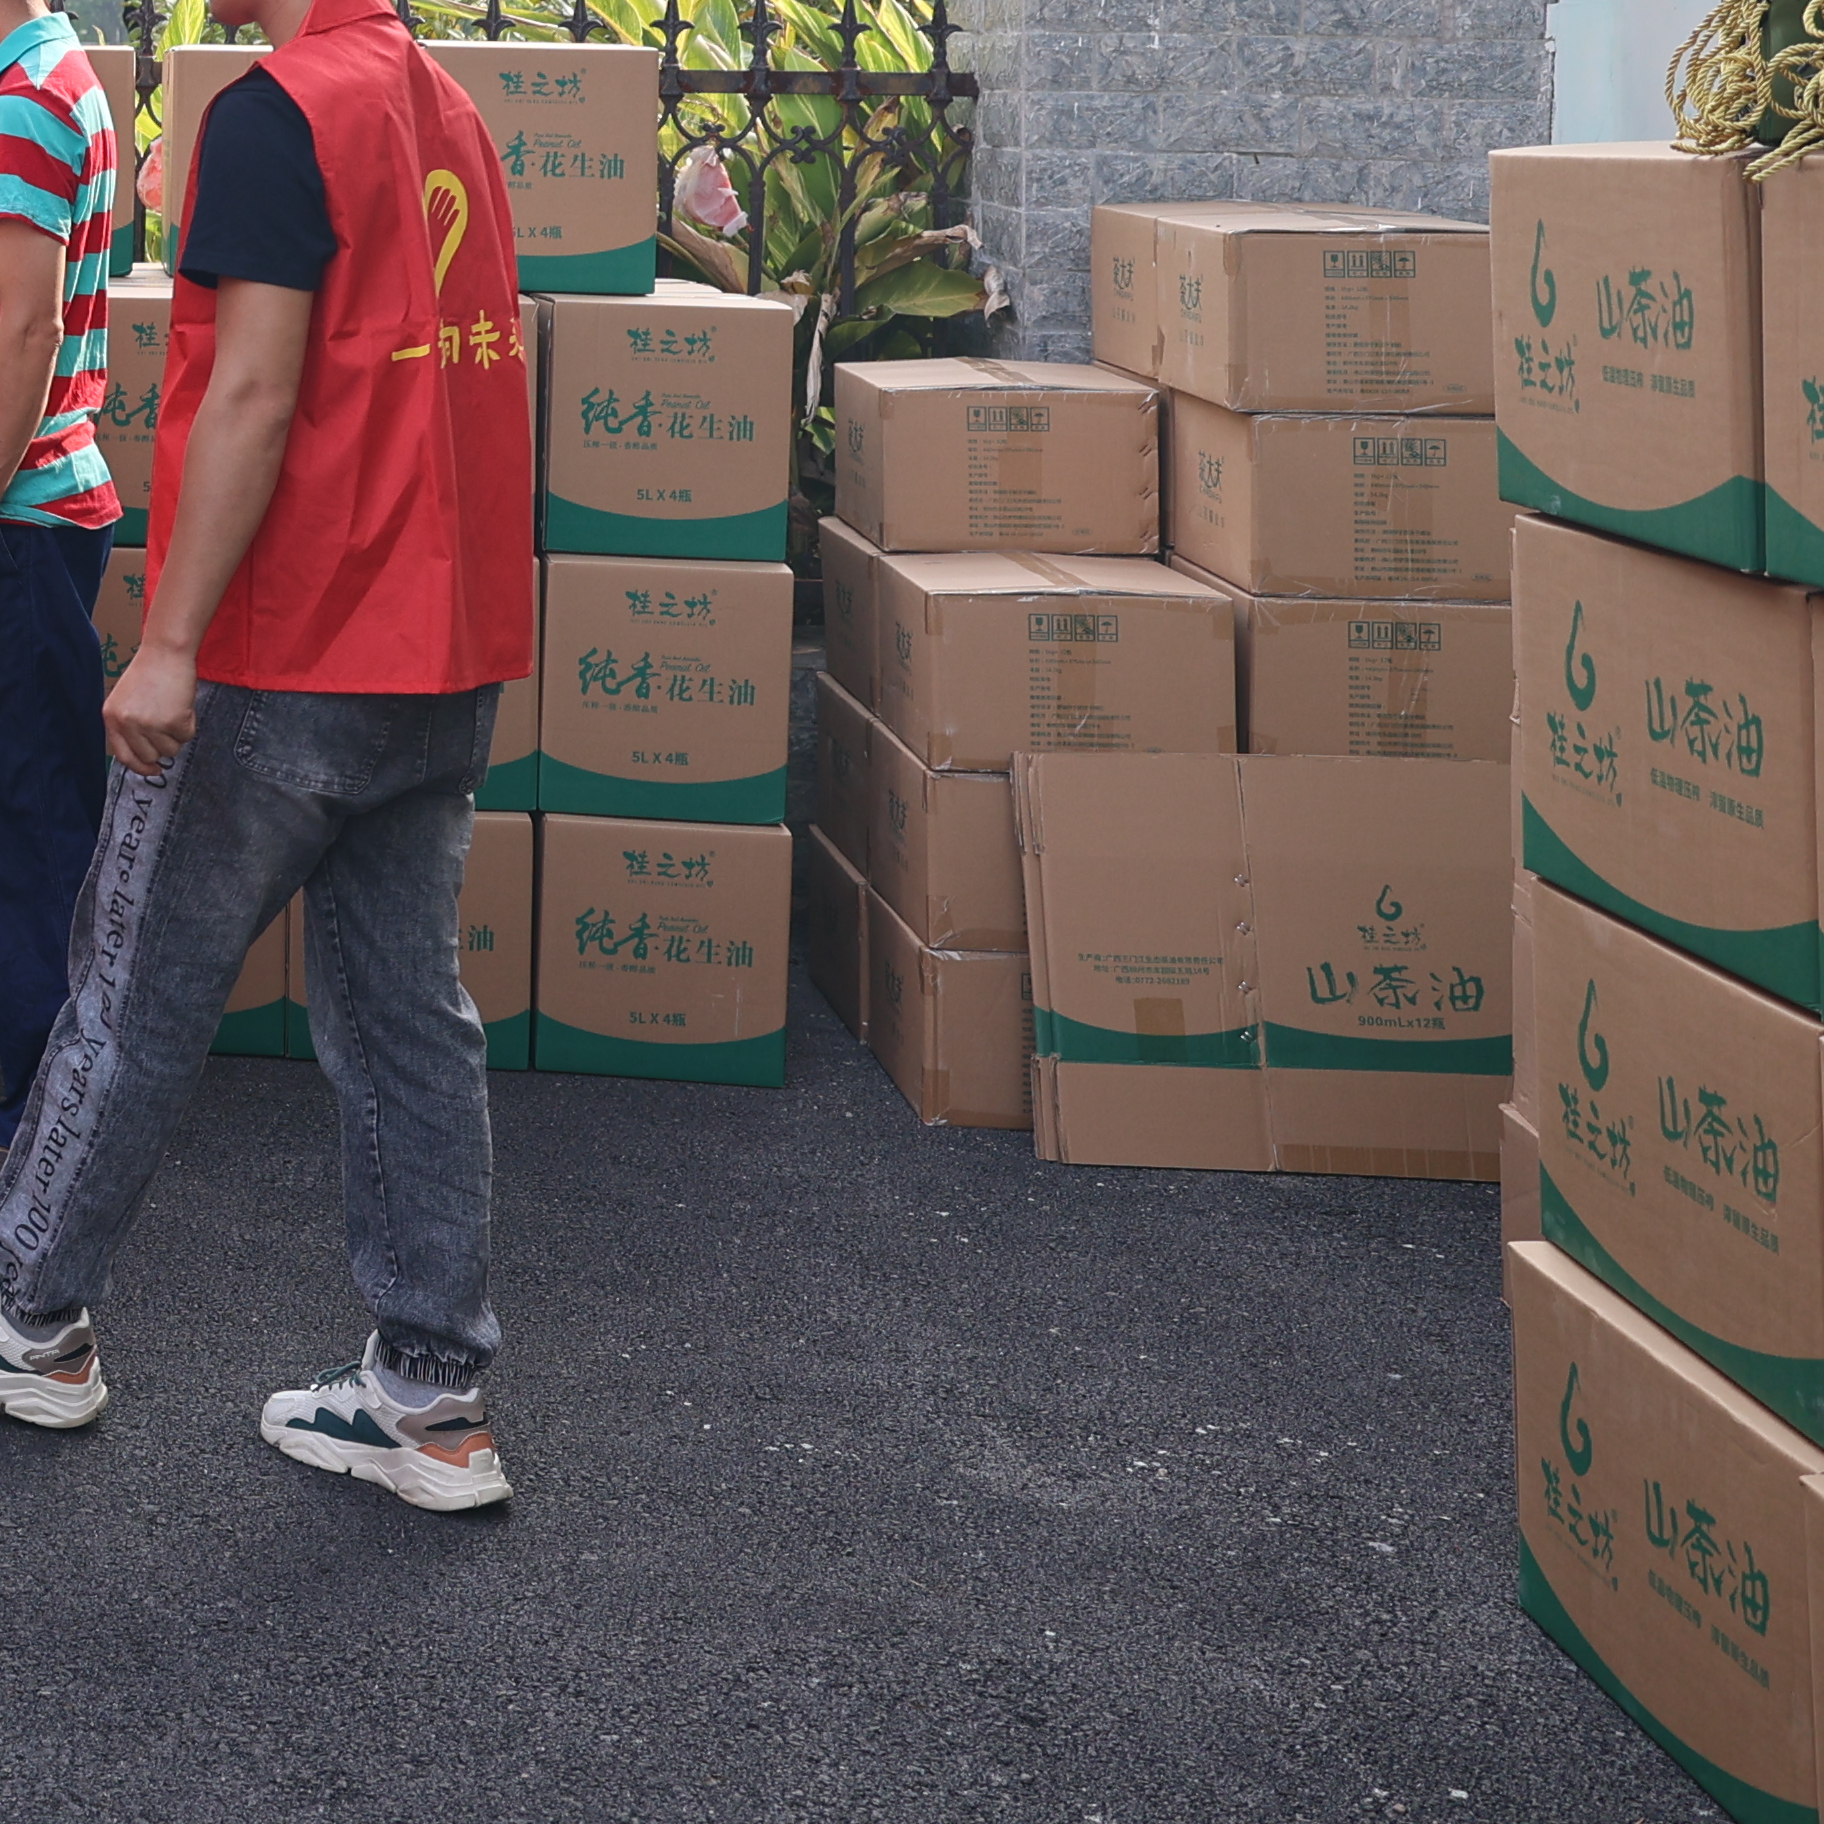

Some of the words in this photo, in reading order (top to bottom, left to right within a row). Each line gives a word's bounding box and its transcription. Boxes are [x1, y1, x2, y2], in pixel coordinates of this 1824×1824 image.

[499, 70, 582, 98] 桂之坊
[533, 139, 563, 149] Peanut
[1595, 265, 1695, 351] 山茶油
[627, 327, 712, 358] 桂之坊
[1514, 336, 1576, 400] 桂之坊
[661, 398, 692, 410] Peanut
[625, 589, 713, 621] 桂之坊
[659, 661, 692, 673] Peanut
[1547, 712, 1619, 794] 桂之坊
[1646, 676, 1764, 780] 山茶油
[623, 850, 711, 882] 桂之坊
[102, 887, 135, 968] later
[1358, 925, 1422, 946] 桂之坊
[1306, 961, 1485, 1012] 山茶油
[60, 1028, 106, 1118] years
[34, 1116, 81, 1195] later
[1558, 1082, 1631, 1180] 桂之坊
[1658, 1075, 1780, 1204] 山茶油
[13, 1191, 52, 1252] 100
[1541, 1456, 1615, 1572] 桂之坊
[1644, 1479, 1770, 1638] 山茶油
